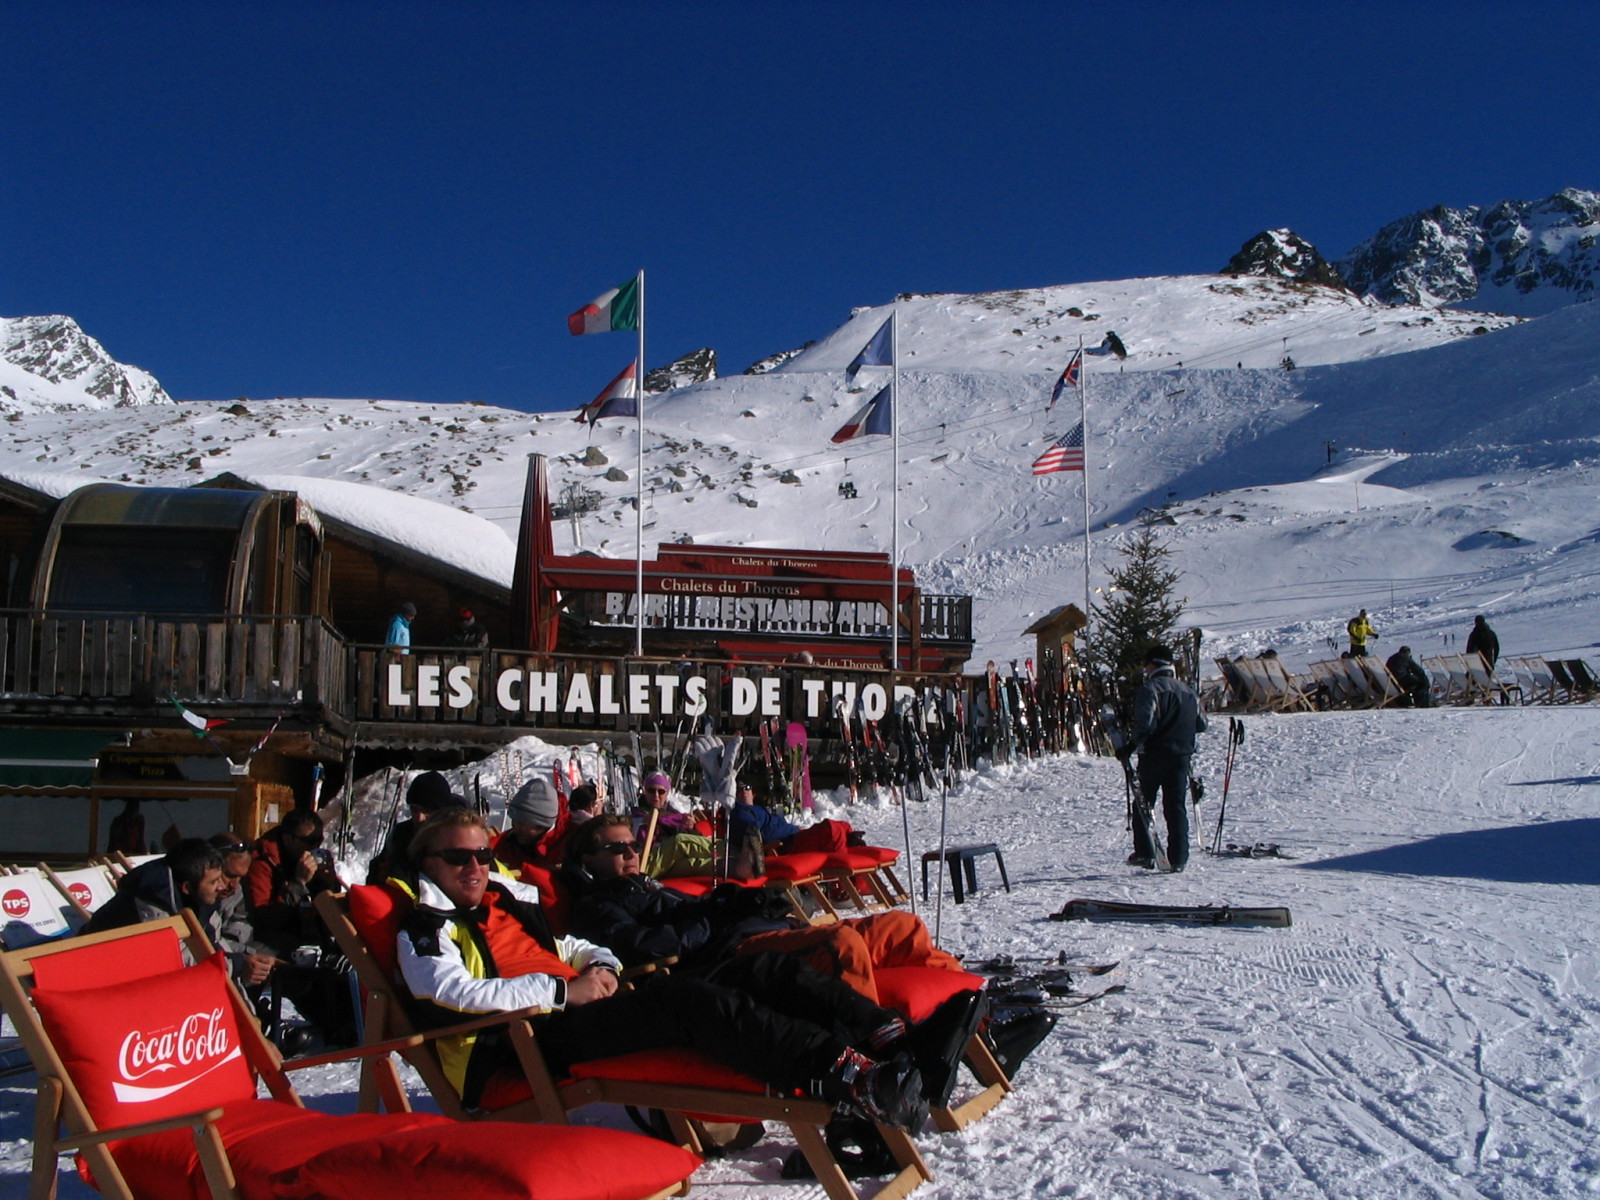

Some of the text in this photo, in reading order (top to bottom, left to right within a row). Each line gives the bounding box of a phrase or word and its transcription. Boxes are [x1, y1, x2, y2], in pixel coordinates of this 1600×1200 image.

[731, 557, 764, 567] Chalets
[766, 558, 779, 567] du
[660, 577, 801, 596] Chalets du Thorens
[606, 592, 665, 617] BAR
[840, 658, 884, 670] Thorens
[387, 664, 473, 709] LES
[496, 668, 708, 716] CHALETS
[731, 677, 782, 716] DE
[3, 898, 29, 909] TPS
[118, 1006, 229, 1081] Coca-Cola
